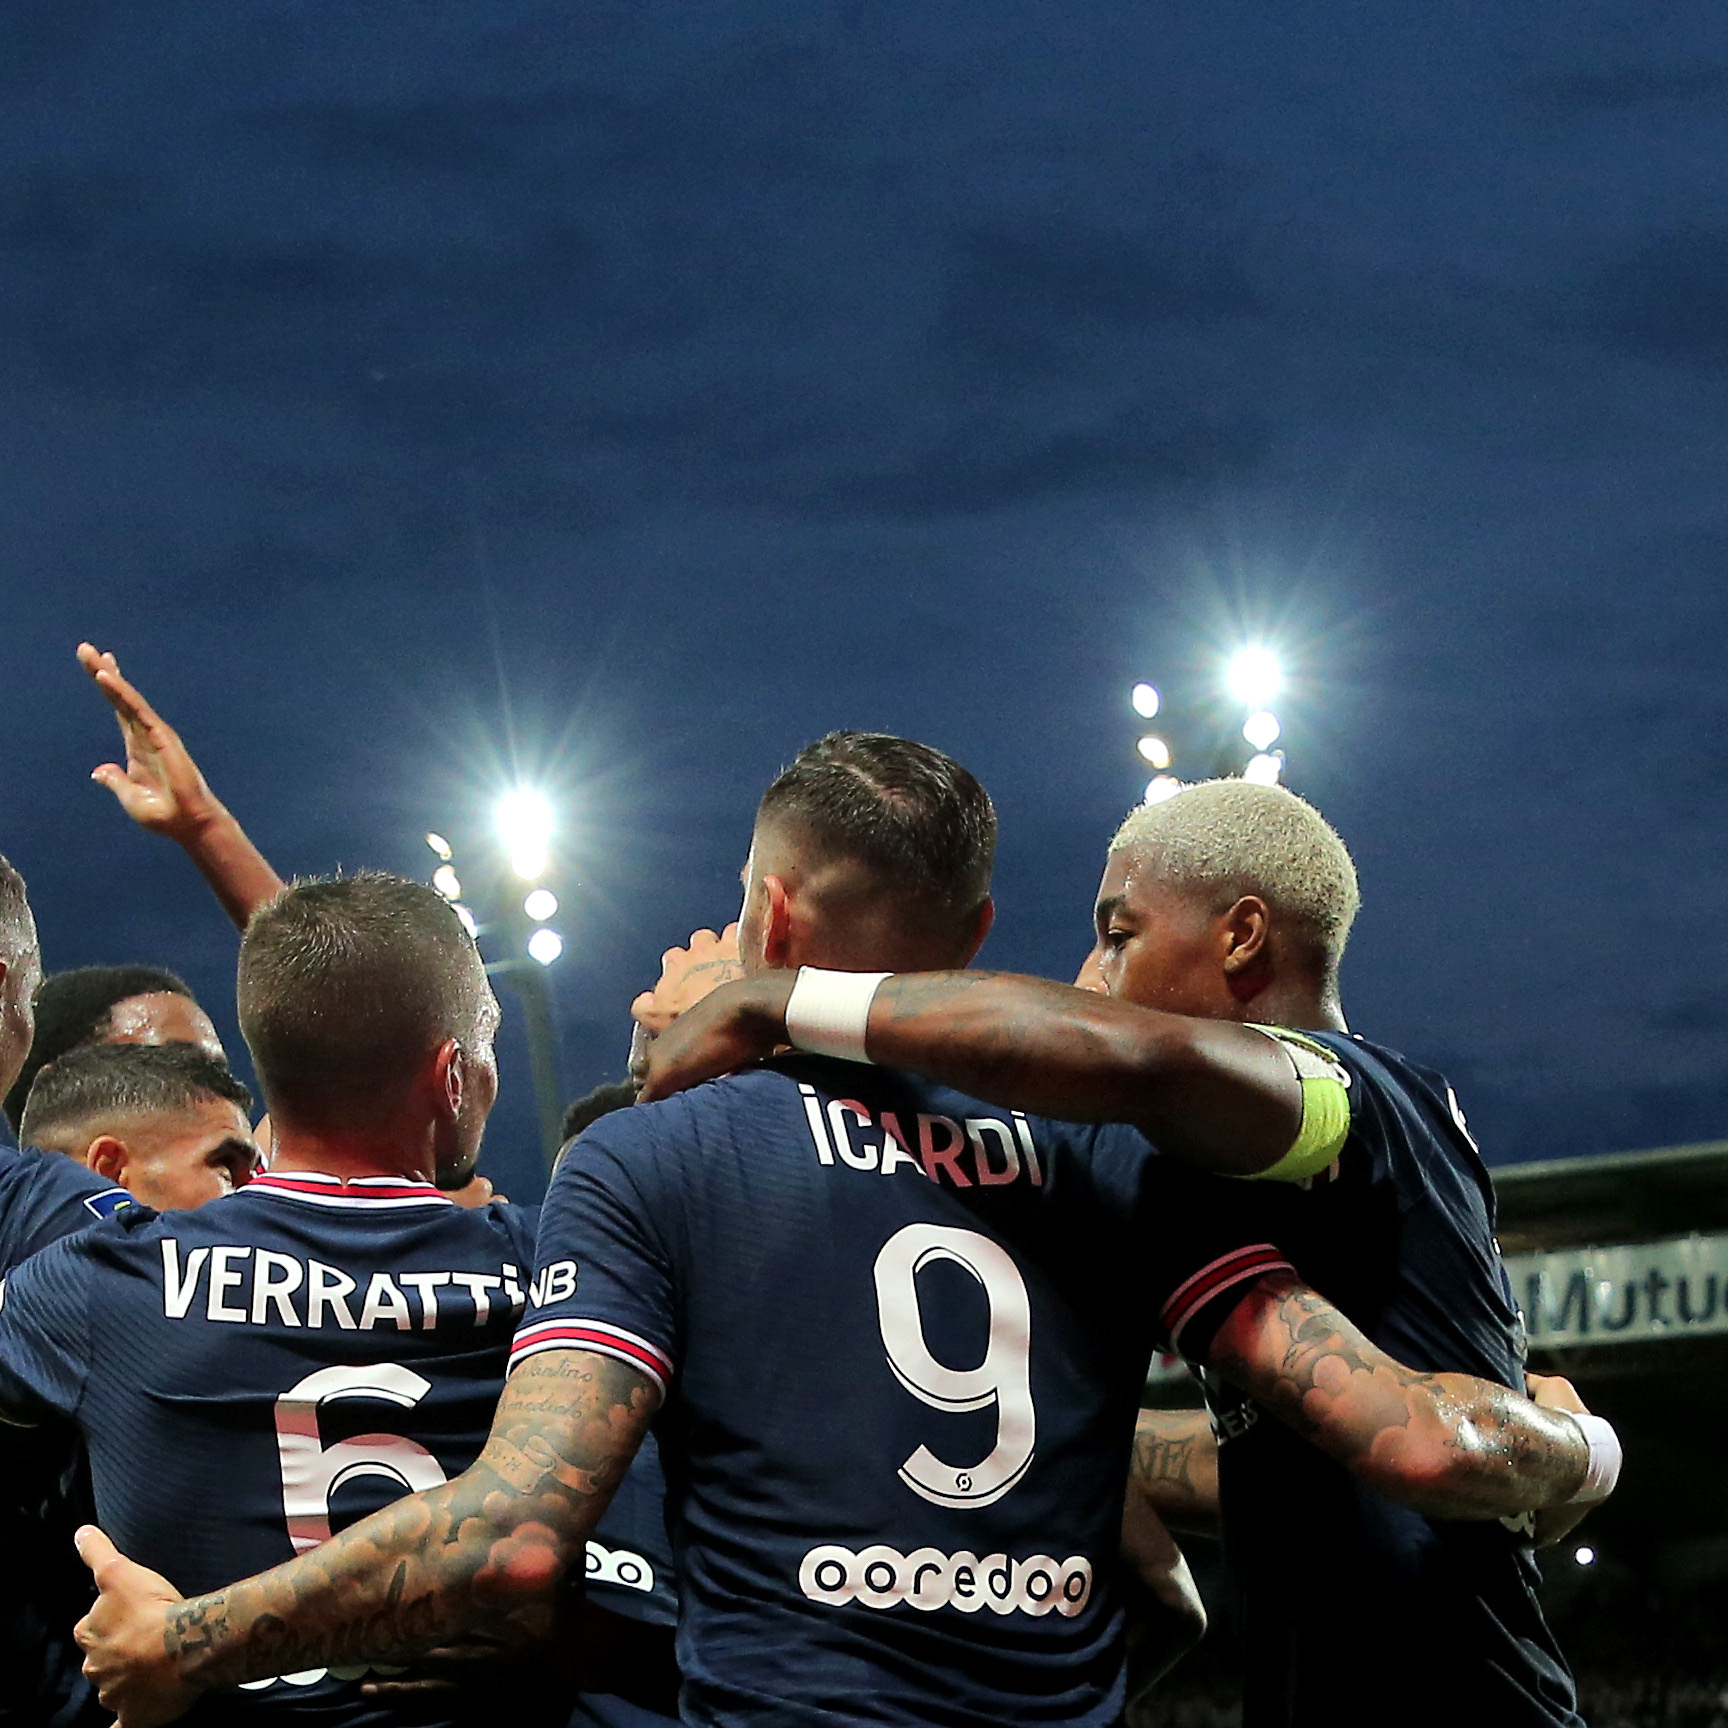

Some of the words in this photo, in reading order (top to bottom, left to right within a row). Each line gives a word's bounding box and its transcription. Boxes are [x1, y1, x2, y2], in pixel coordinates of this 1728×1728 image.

[274, 1361, 450, 1556] 6
[873, 1222, 1036, 1509] 9
[798, 1544, 1093, 1618] ooredoo
